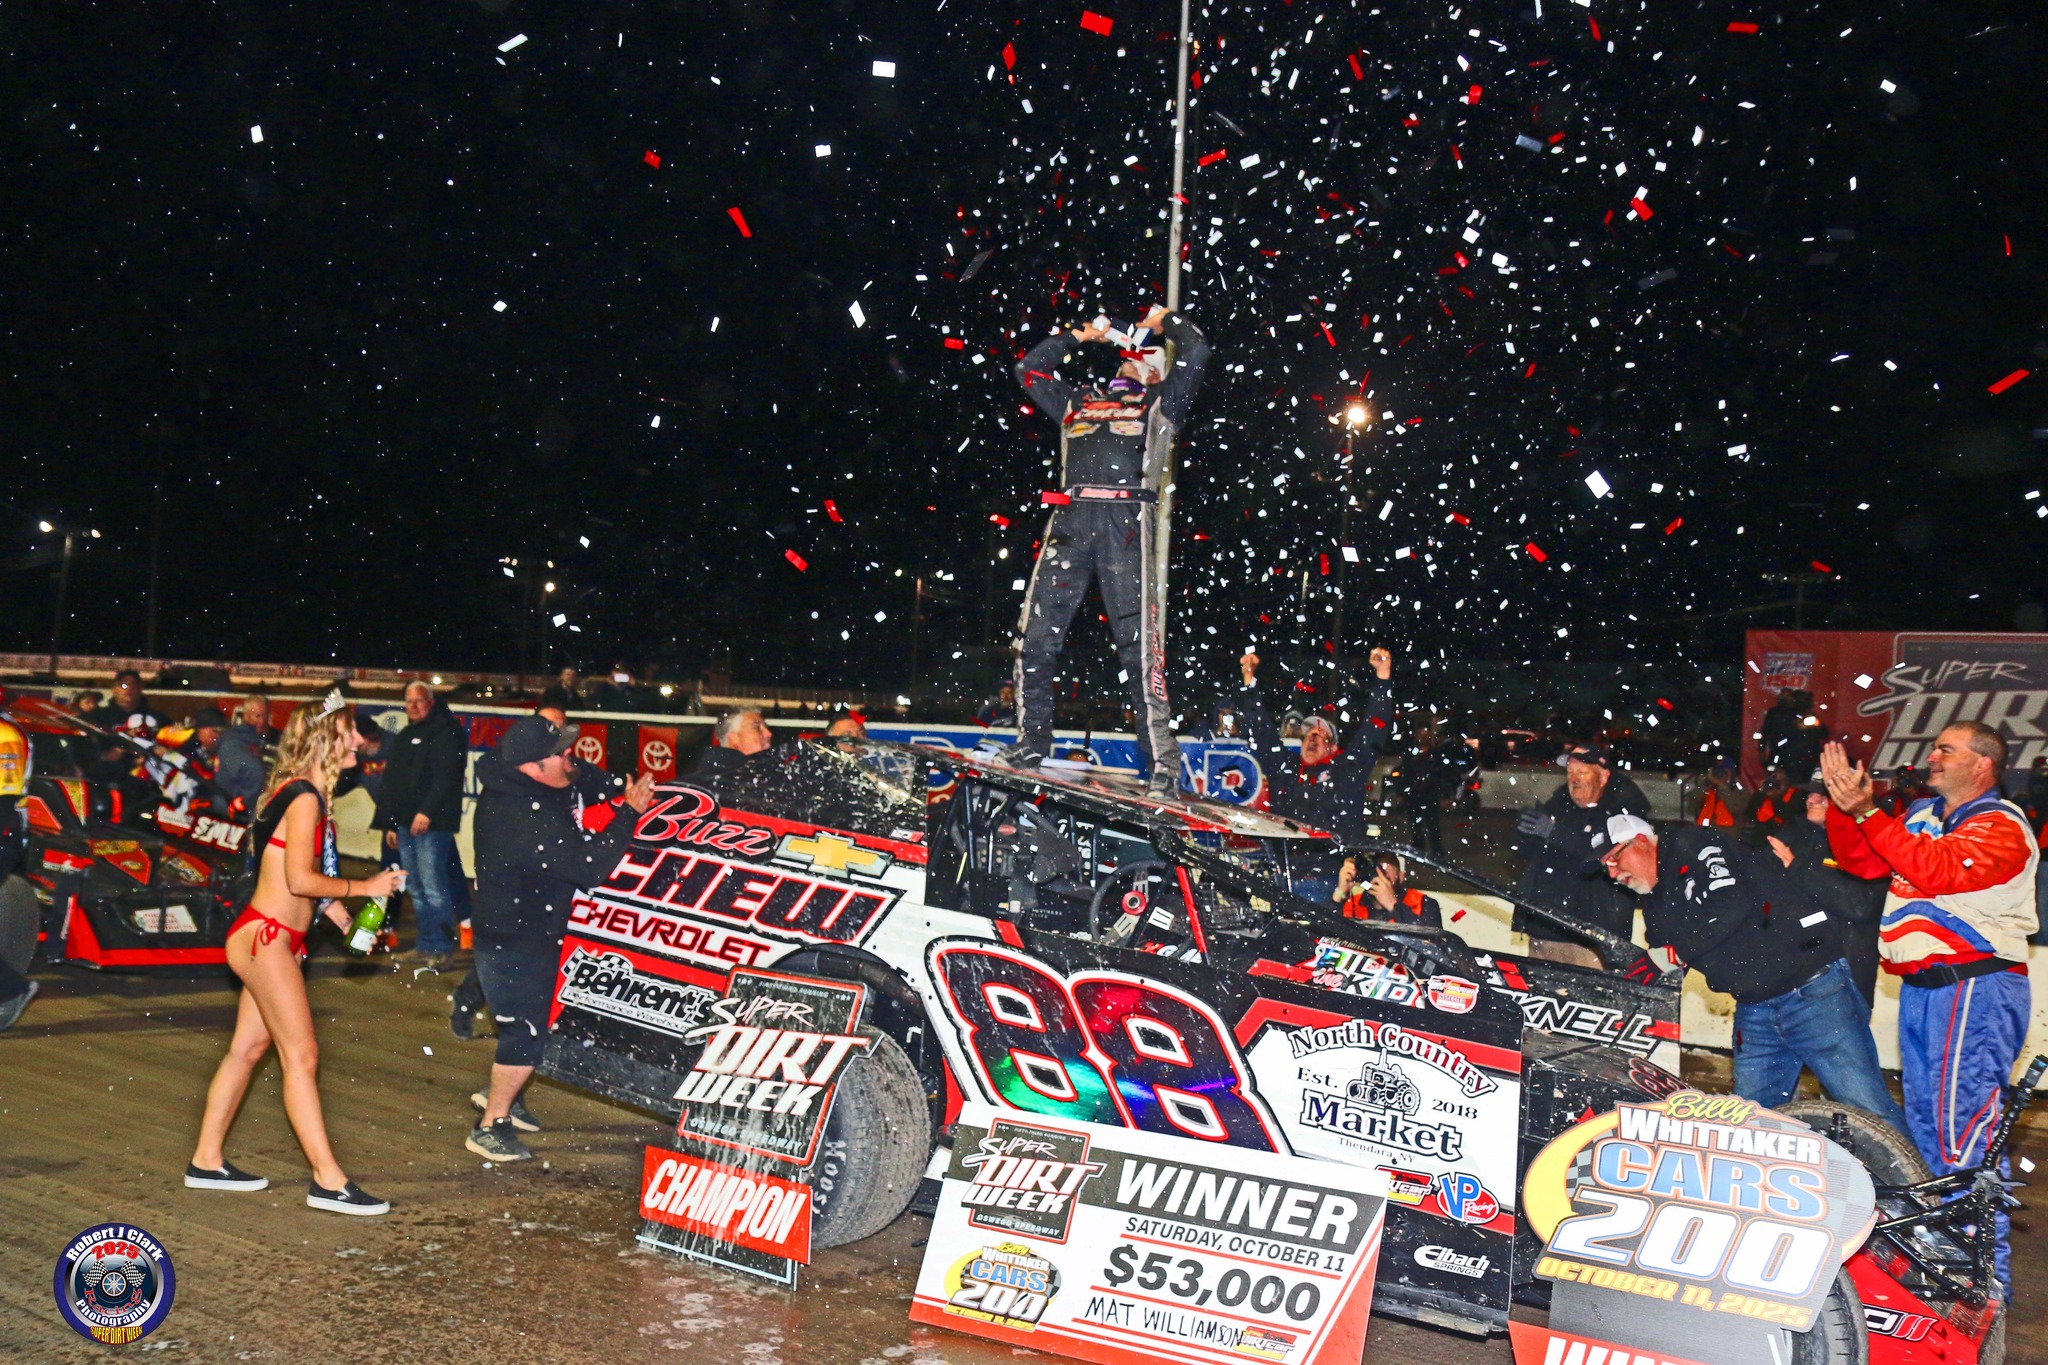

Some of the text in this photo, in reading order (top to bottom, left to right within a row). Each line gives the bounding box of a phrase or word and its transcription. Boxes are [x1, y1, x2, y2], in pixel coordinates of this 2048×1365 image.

[1861, 660, 2036, 712] SUPER
[632, 785, 772, 856] Buzz
[600, 846, 889, 944] CHEW
[570, 898, 771, 966] CHEVROLET
[635, 1008, 691, 1032] Warehous
[685, 996, 815, 1039] SUPER
[694, 1025, 872, 1087] DIRT
[936, 945, 1281, 1154] 88
[1291, 1021, 1498, 1098] North Country
[673, 1070, 823, 1116] WEEK
[1297, 1067, 1478, 1120] Est. 2018
[1666, 1095, 1755, 1122] Billy
[690, 1118, 803, 1151] OSWEGO SPEEDWAY
[963, 1137, 1058, 1164] SUPER
[1303, 1091, 1463, 1160] Market
[1619, 1107, 1824, 1167] WHITTAKER
[974, 1155, 1100, 1196] DIRT
[1399, 1151, 1416, 1163] NY
[1597, 1141, 1826, 1220] CARS
[643, 1159, 808, 1245] CHAMPION
[961, 1184, 1070, 1214] WEEK
[1116, 1158, 1359, 1245] WINNER
[1441, 1176, 1481, 1219] VP
[1465, 1201, 1497, 1216] Racing
[976, 1213, 1061, 1237] OSWEGO SPEEDWAY
[1125, 1216, 1345, 1272] SATURDAY, OCTOBER 11
[1546, 1188, 1837, 1301] 200
[971, 1260, 1048, 1292] CARS
[982, 1246, 1050, 1272] WHITTAKER
[1103, 1244, 1321, 1321] $53,000
[1414, 1245, 1490, 1271] Eibach
[1433, 1261, 1480, 1277] SPRINGS
[951, 1278, 1049, 1321] 200
[1536, 1257, 1815, 1329] OCTOBER 11, 2025
[1085, 1297, 1246, 1349] MAT WILLIAMSON
